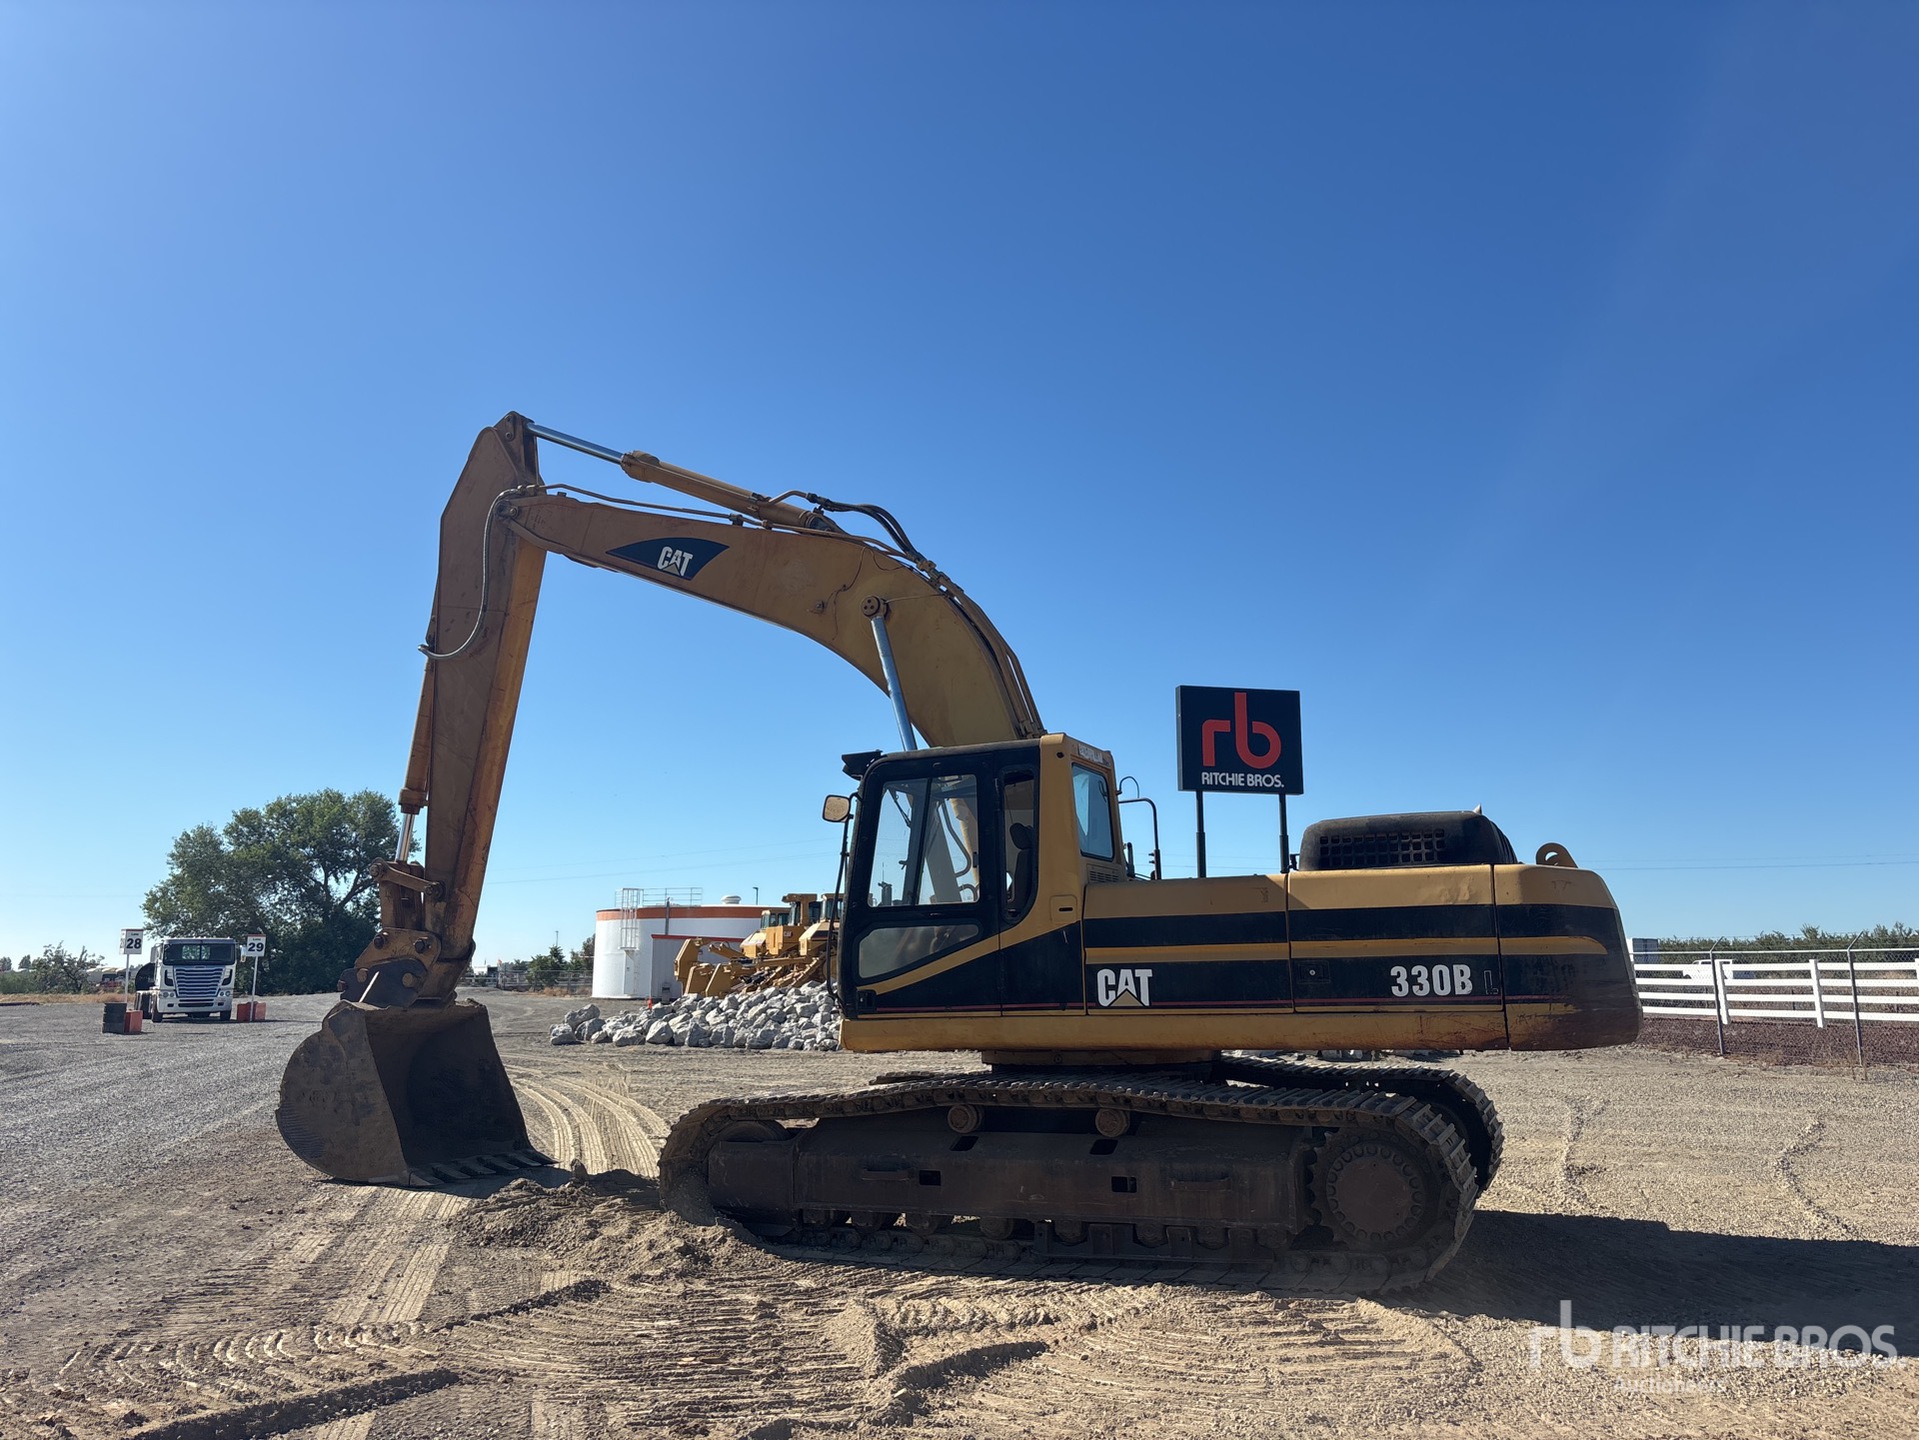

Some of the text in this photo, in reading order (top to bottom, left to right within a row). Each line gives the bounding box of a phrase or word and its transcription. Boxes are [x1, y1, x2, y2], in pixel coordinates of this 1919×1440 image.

[657, 546, 694, 576] CAT
[1201, 692, 1282, 769] rb
[1201, 772, 1285, 788] RITCHIE BROS.
[126, 938, 142, 949] 28
[248, 942, 264, 952] 29
[1097, 968, 1153, 1007] CAT
[1390, 964, 1473, 997] 330B
